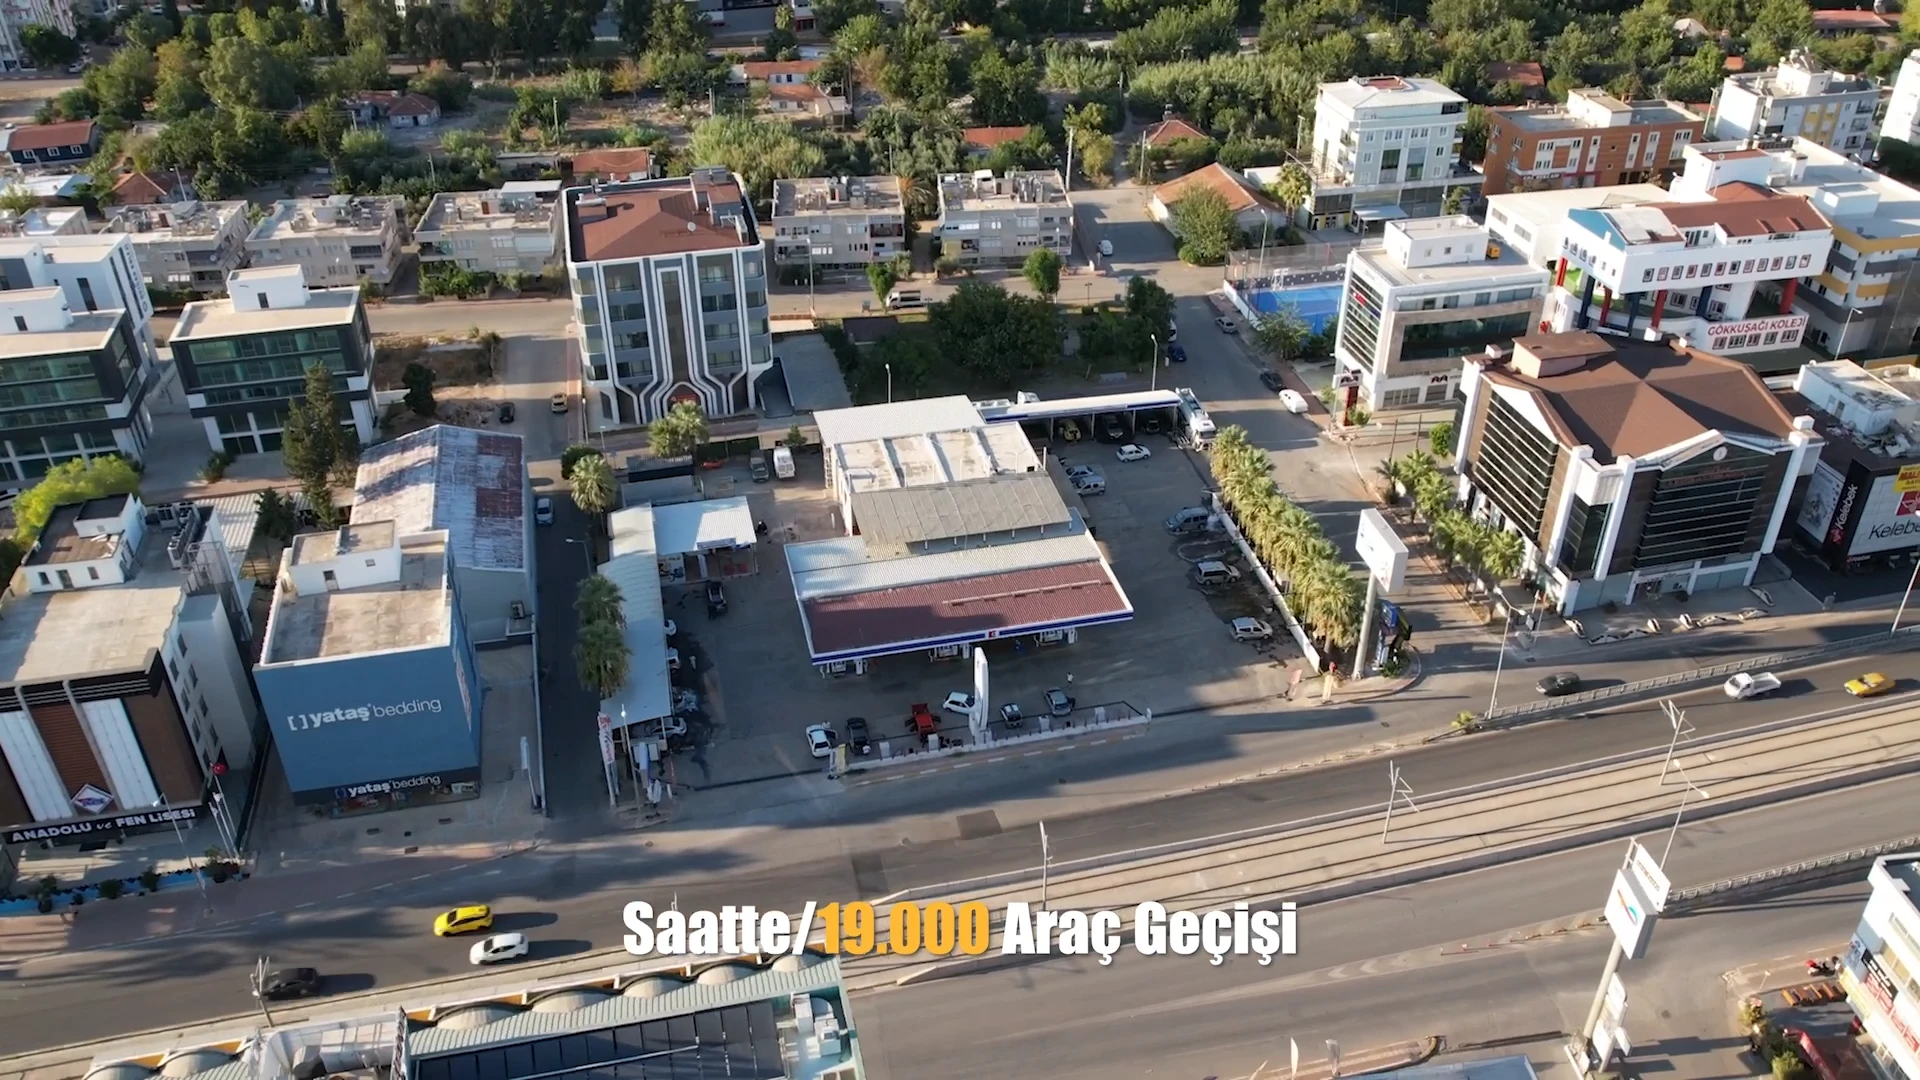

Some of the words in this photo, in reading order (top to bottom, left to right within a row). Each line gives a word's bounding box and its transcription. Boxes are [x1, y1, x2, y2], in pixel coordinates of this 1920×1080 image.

[1835, 483, 1859, 530] Kelebek
[310, 705, 371, 728] yataş
[373, 699, 442, 717] bedding
[348, 782, 391, 797] yataş
[392, 775, 441, 789] bedding
[12, 822, 92, 843] ANADOLU
[97, 821, 113, 831] ve
[115, 814, 147, 828] FEN
